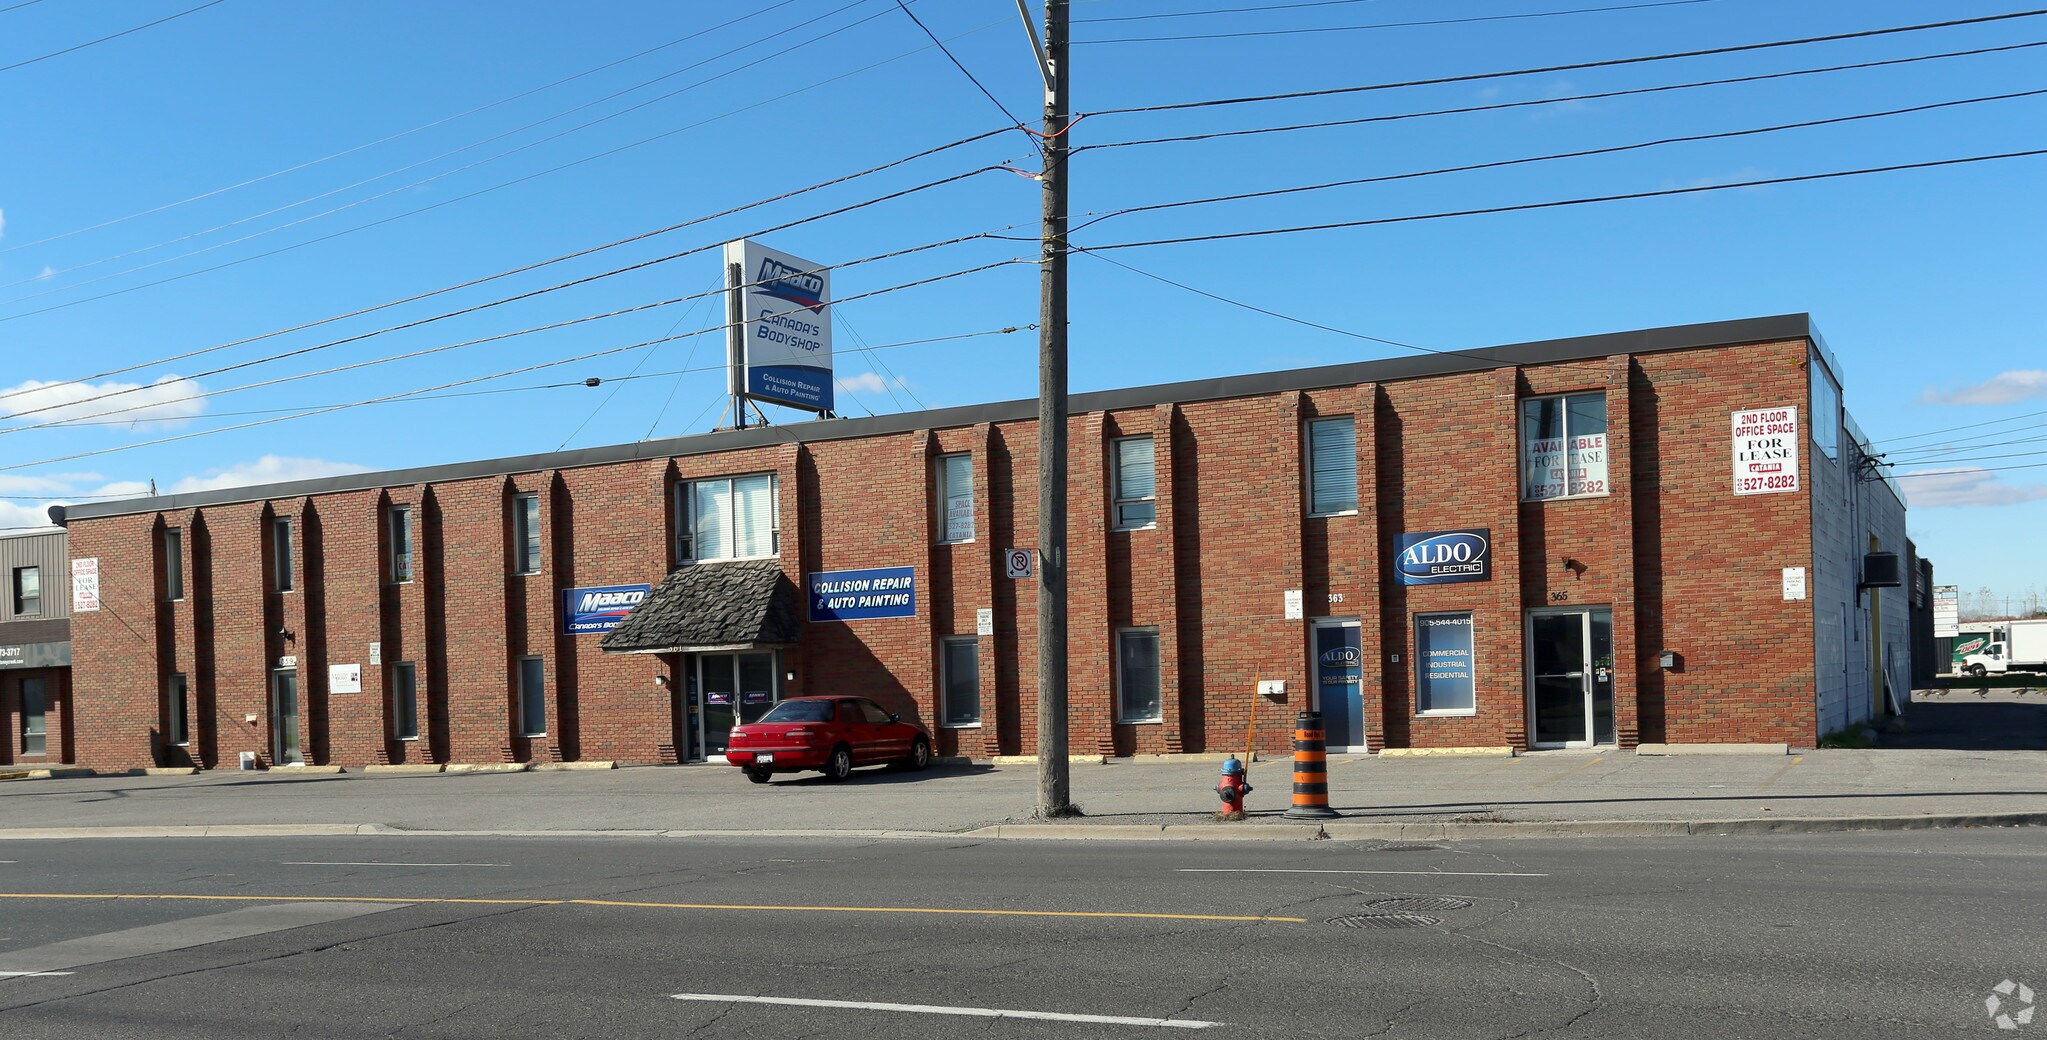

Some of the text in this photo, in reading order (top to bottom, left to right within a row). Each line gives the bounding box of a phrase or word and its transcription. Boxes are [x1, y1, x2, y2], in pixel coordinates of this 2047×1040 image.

[1741, 411, 1788, 424] 2ND FLOOR
[1735, 422, 1794, 437] OFFICE SPACE
[1532, 437, 1603, 453] AVAIABLE
[1747, 438, 1782, 450] FOR
[1534, 451, 1603, 468] FOR EASE
[1739, 448, 1793, 461] LEASE
[1750, 463, 1780, 472] CATANIA
[1540, 480, 1604, 497] 5278282
[1403, 542, 1471, 565] ALDO
[1431, 563, 1481, 574] ELECTRIC
[814, 577, 912, 594] COLLISION REPAIR
[817, 593, 910, 610] & AUTO PAINTING
[1328, 593, 1343, 603] 363
[1551, 591, 1568, 601] 365
[1322, 651, 1354, 661] ALDO
